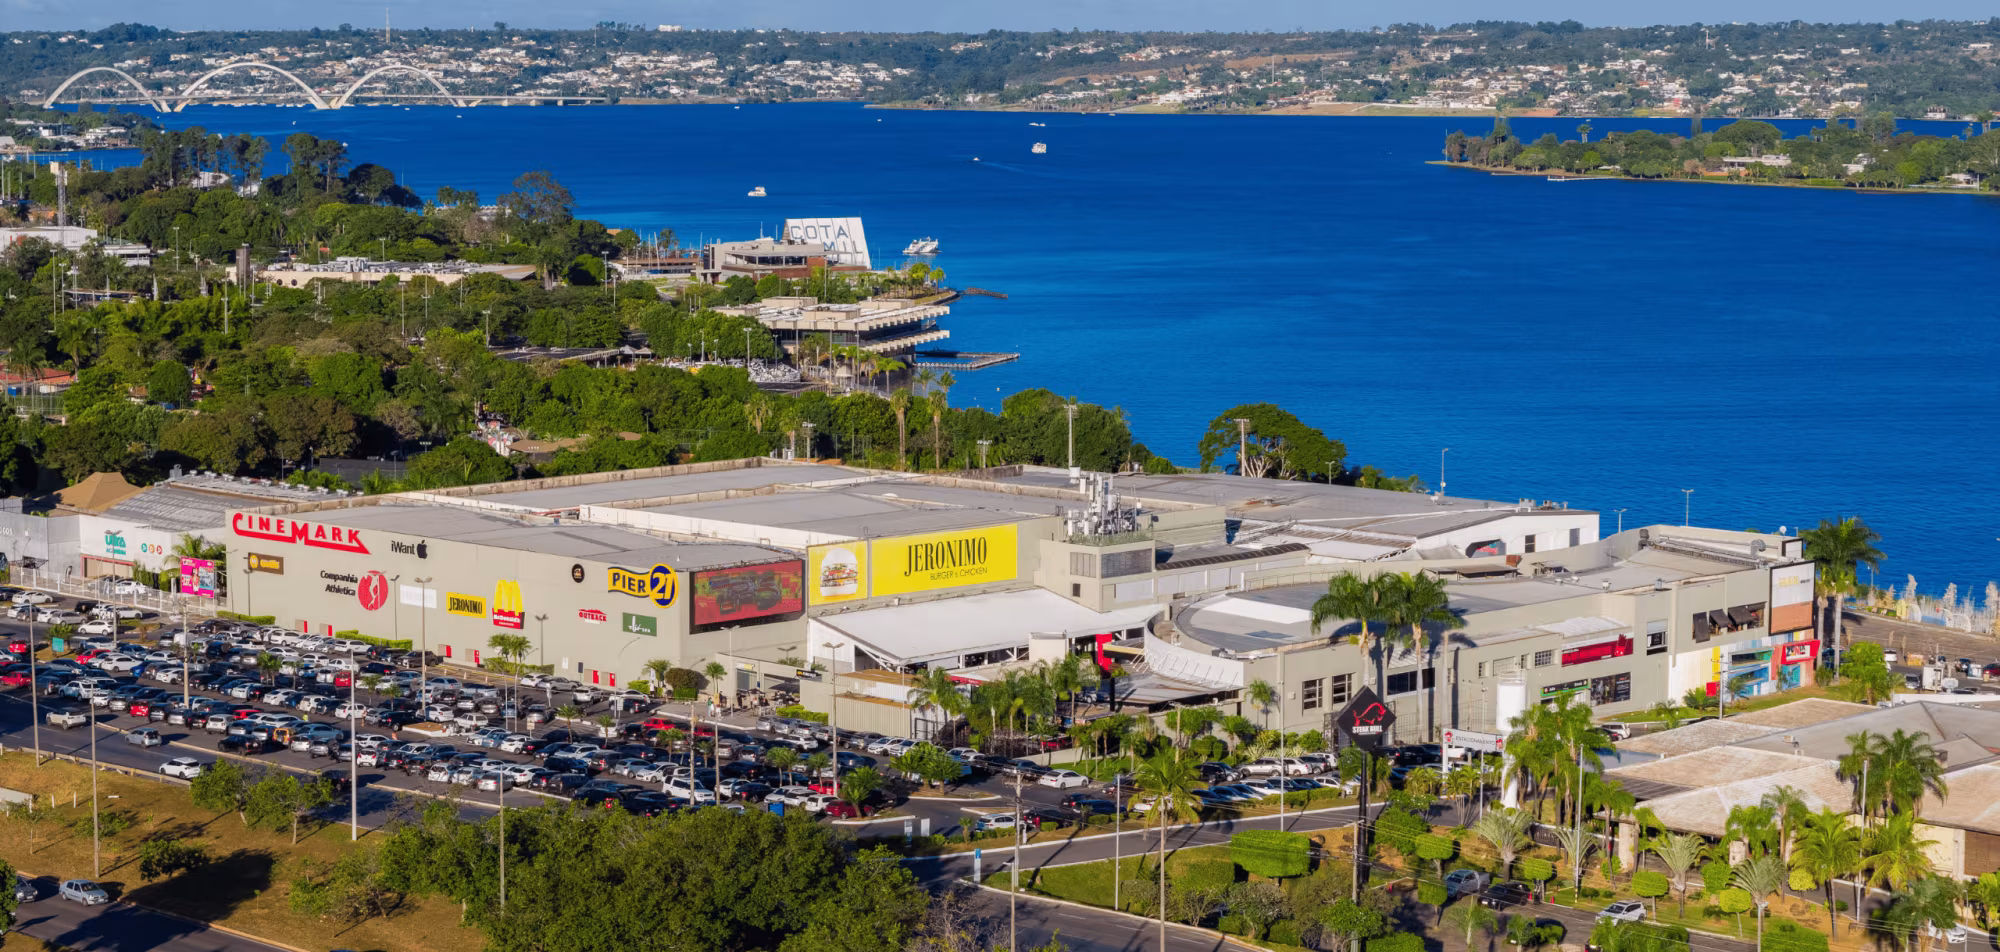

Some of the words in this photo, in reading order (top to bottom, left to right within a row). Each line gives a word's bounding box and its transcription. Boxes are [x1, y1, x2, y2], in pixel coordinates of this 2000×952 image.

[790, 225, 849, 240] COTA
[824, 241, 863, 254] MIL
[232, 512, 371, 554] CINEMARK
[391, 540, 415, 555] iWant
[904, 536, 987, 577] JERONIMO
[320, 570, 358, 584] Companhia
[930, 571, 954, 580] BURGER
[959, 566, 988, 577] CHICKEN
[325, 583, 356, 596] Athletica
[612, 572, 646, 593] PIER
[650, 571, 675, 600] 21
[448, 597, 483, 614] JERONIMO
[578, 611, 607, 622] OUTBACK
[1352, 726, 1370, 734] STEAK
[1455, 735, 1496, 746] ESTACIONAMENTO
